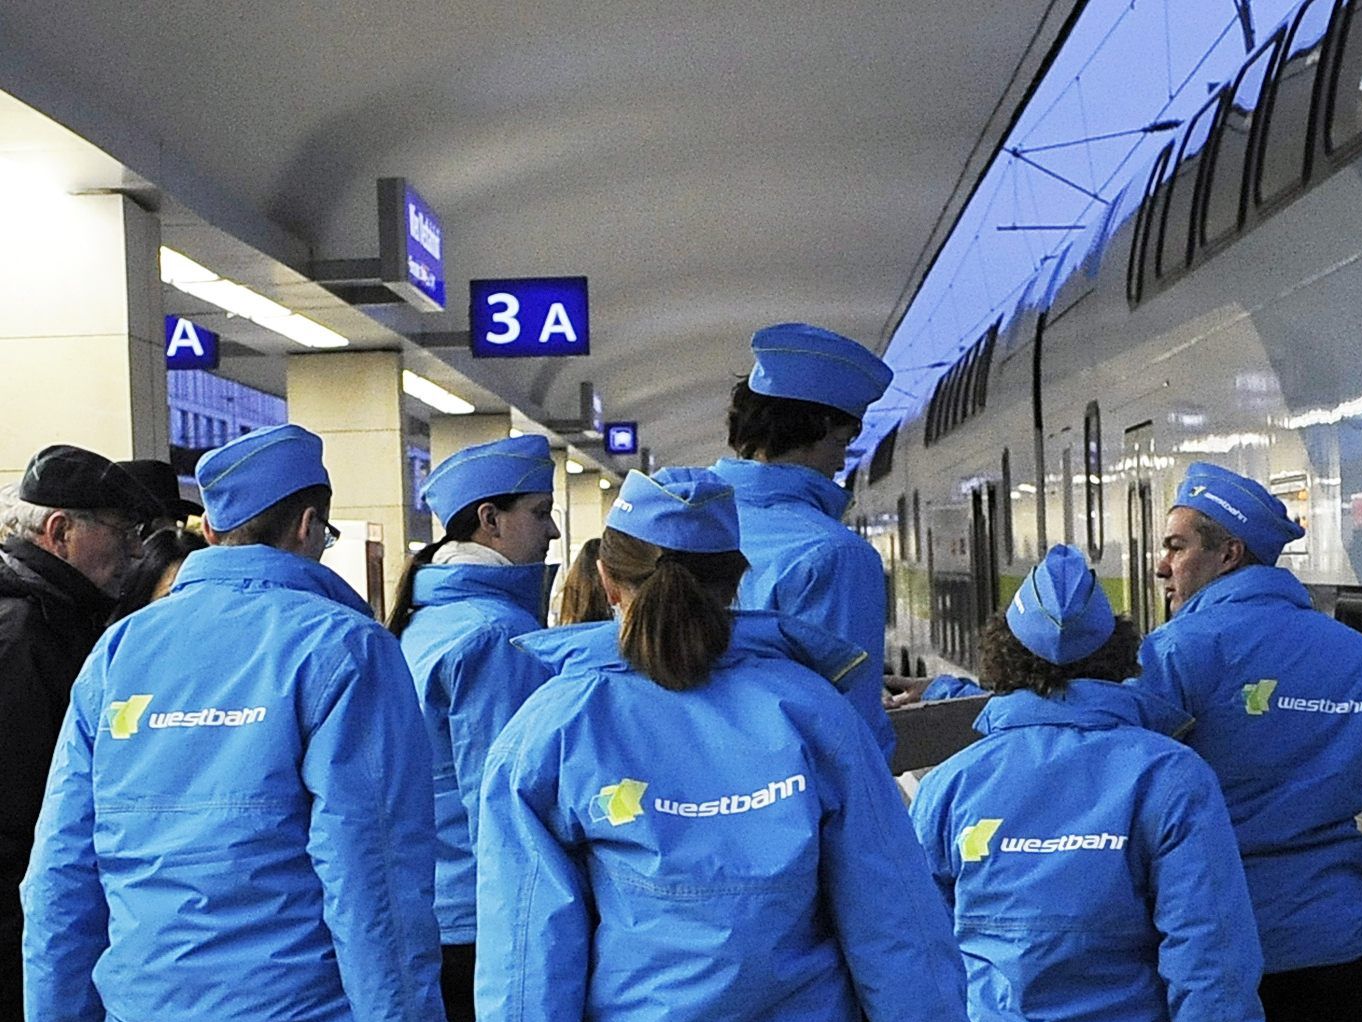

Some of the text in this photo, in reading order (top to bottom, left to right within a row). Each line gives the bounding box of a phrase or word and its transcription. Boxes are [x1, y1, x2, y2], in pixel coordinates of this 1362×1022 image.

[166, 317, 205, 357] A
[485, 293, 578, 345] 3 A
[655, 773, 807, 817] westbahn
